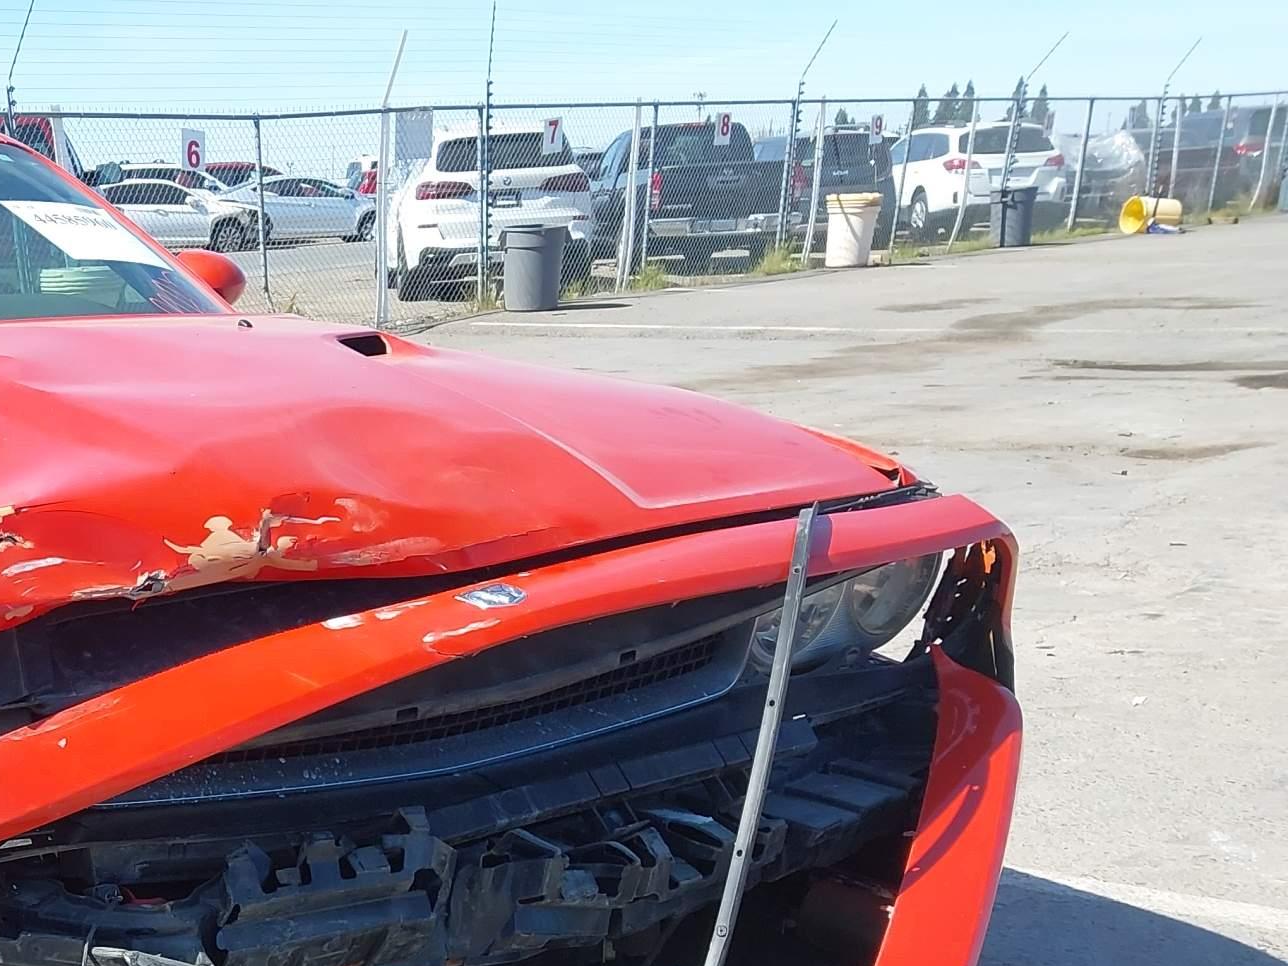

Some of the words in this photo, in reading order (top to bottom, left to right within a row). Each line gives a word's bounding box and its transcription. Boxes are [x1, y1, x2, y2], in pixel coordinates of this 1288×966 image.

[548, 119, 559, 144] 7
[721, 114, 730, 136] 8
[875, 115, 882, 136] 9
[187, 140, 201, 169] 6
